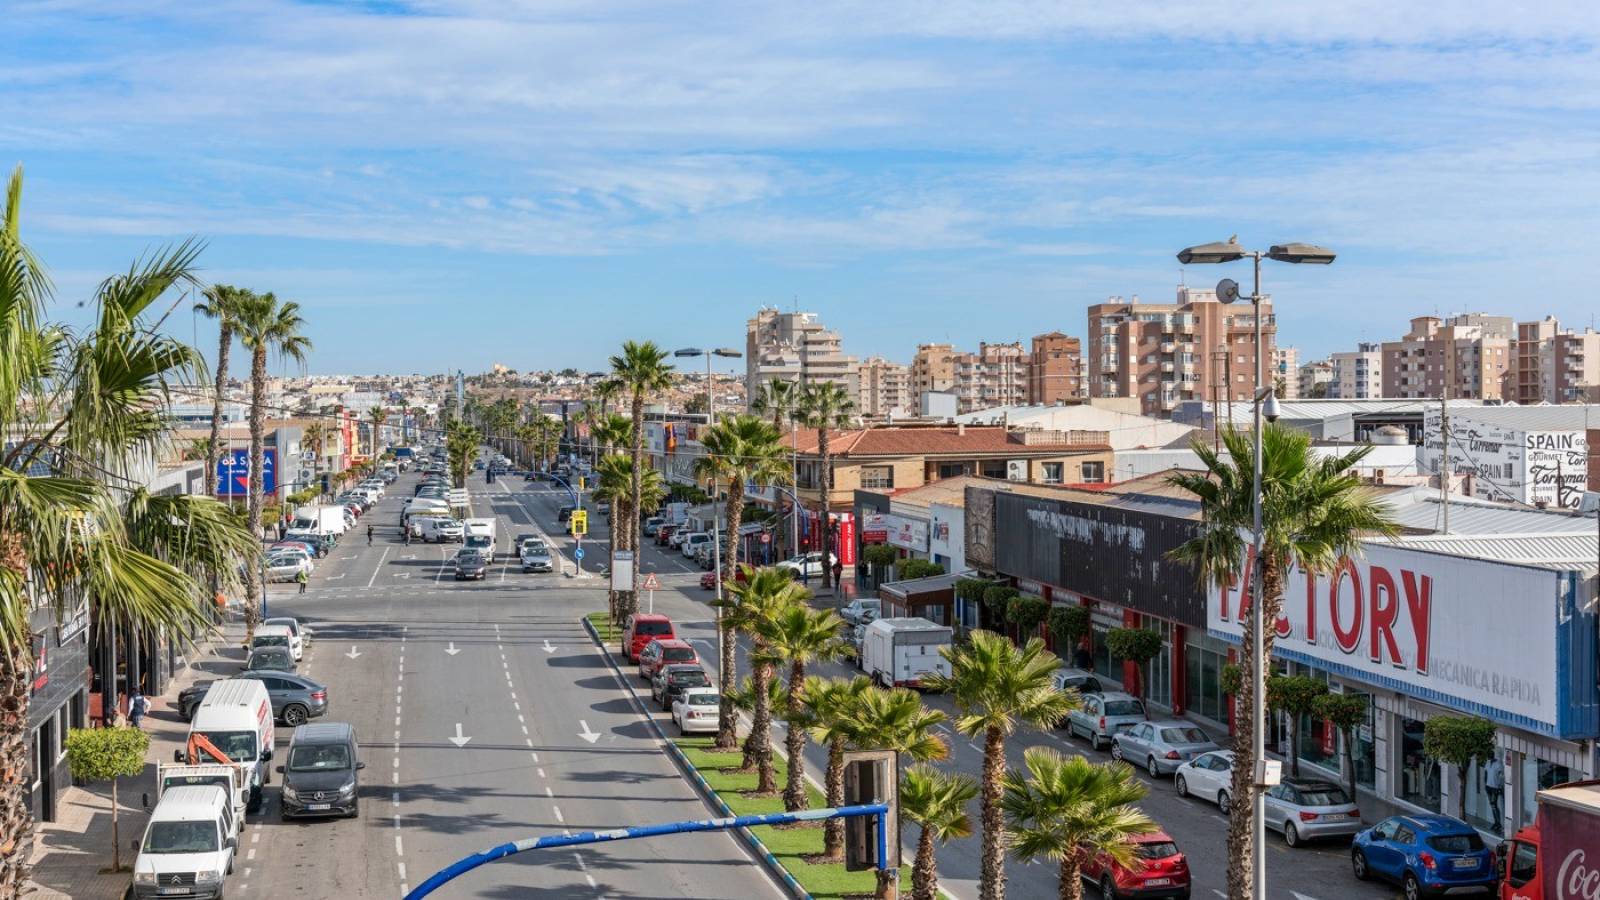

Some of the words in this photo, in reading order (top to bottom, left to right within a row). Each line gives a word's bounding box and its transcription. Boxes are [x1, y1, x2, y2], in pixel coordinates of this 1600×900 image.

[1527, 434, 1572, 449] SPAIN
[1528, 453, 1562, 461] GOURMET
[1480, 464, 1501, 478] SPAIN
[1430, 656, 1490, 692] MECANICA
[1492, 671, 1541, 706] RAPIDA
